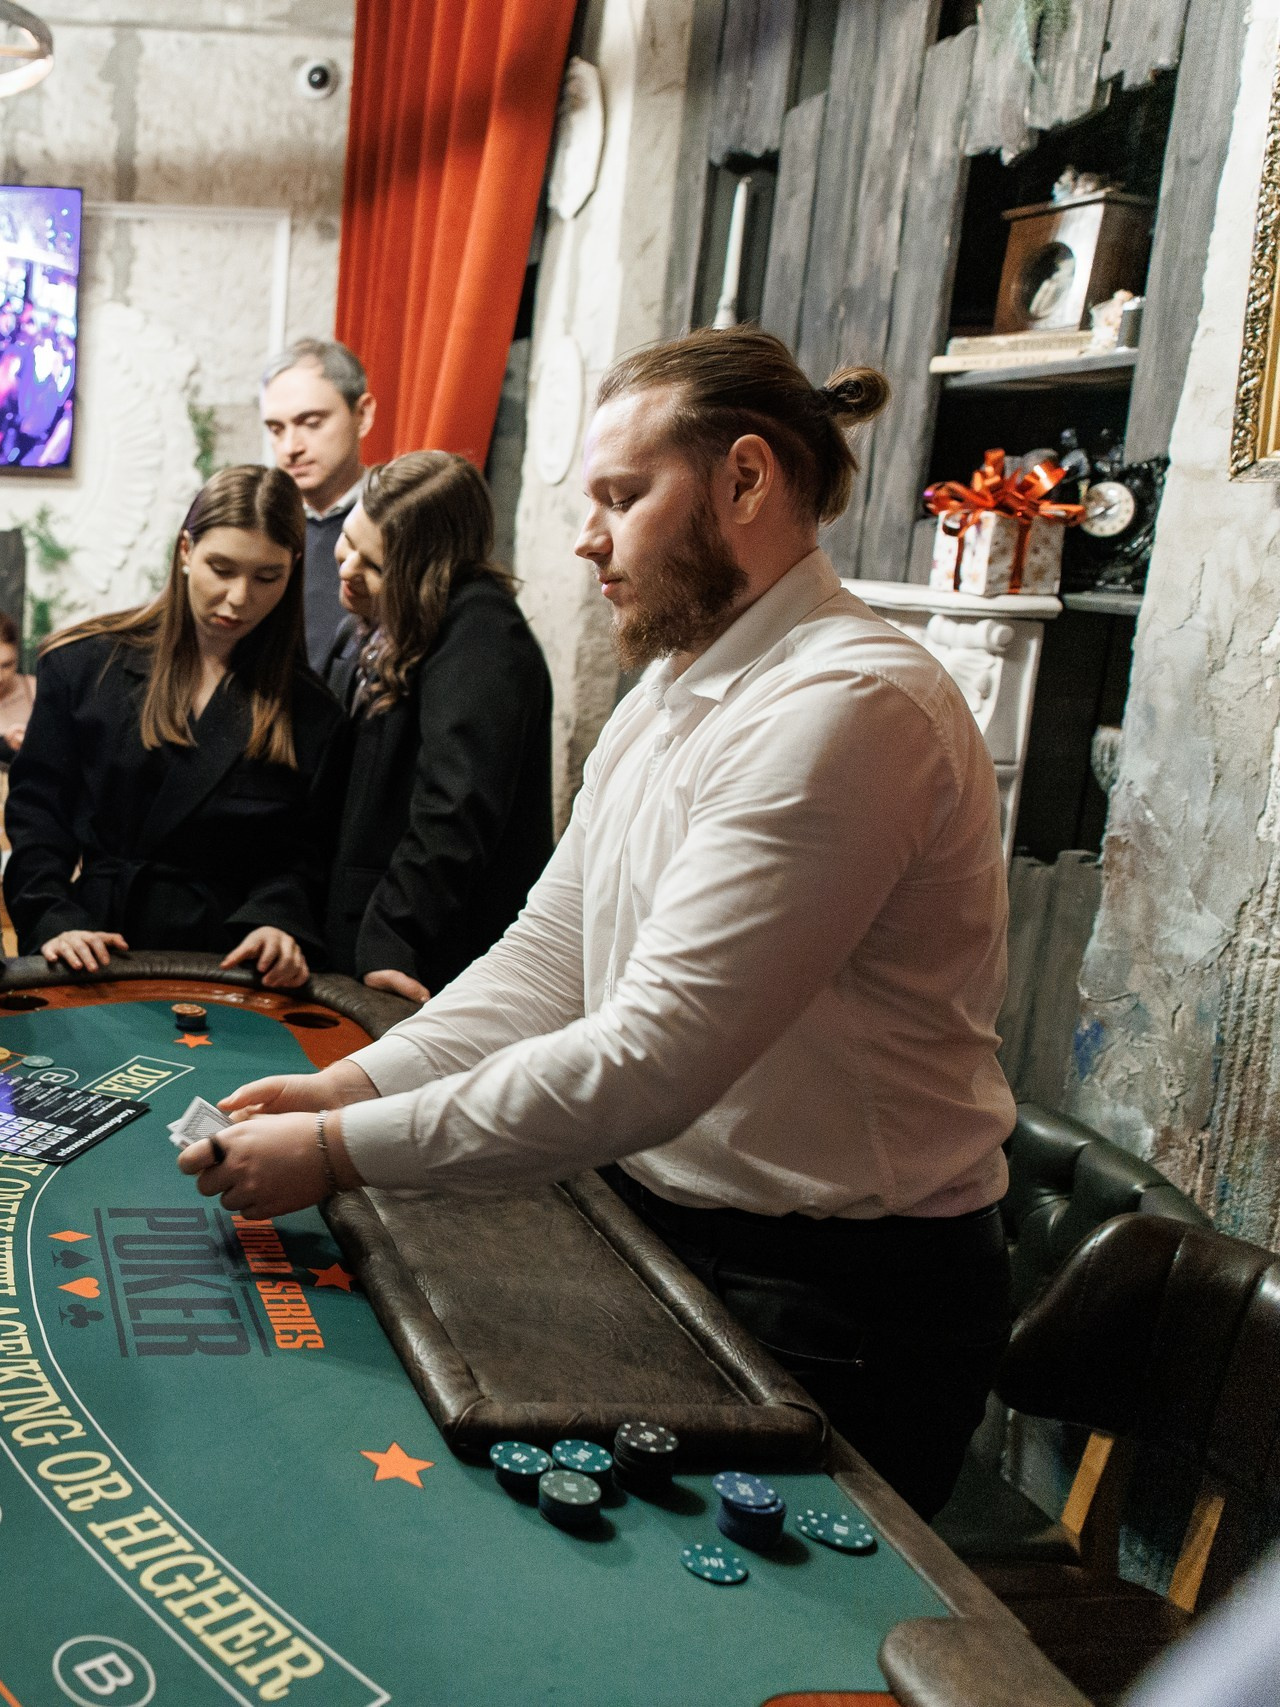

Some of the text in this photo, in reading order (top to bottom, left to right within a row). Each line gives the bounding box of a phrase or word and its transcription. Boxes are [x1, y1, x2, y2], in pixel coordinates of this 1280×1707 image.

[39, 1071, 70, 1083] B
[89, 1064, 173, 1100] DEA
[107, 1207, 251, 1356] POKER
[255, 1281, 325, 1349] SERIES
[36, 1450, 133, 1512] OR
[87, 1505, 325, 1701] HIGHER
[73, 1651, 135, 1696] B
